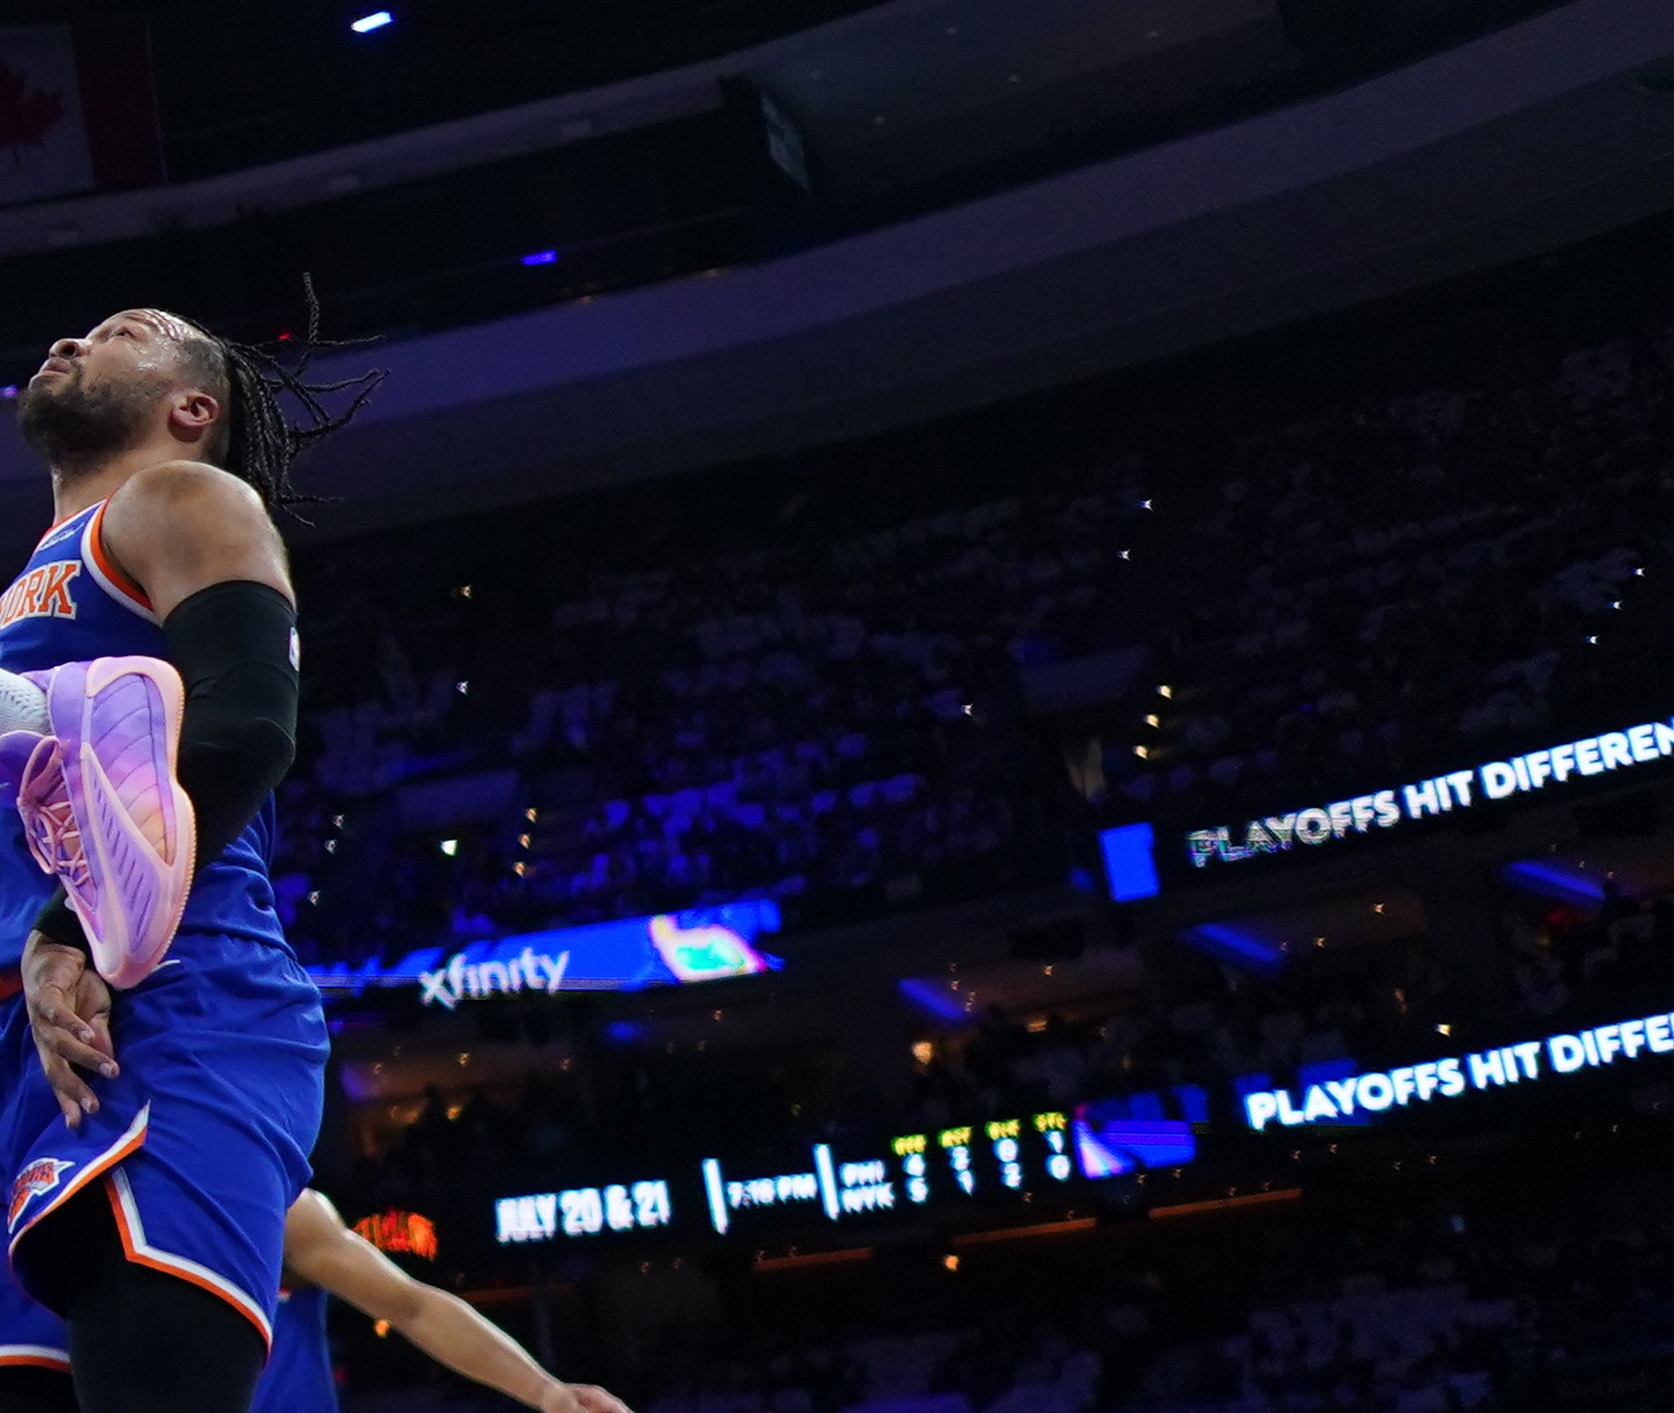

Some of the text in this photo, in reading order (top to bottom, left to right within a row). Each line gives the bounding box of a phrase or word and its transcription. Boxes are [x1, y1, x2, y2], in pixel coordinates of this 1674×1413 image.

[1188, 789, 1402, 868] PLAYOFFS
[1403, 770, 1474, 819] HIT
[417, 946, 570, 1010] xfinity
[1244, 1041, 1541, 1132] PLAYOFFS HIT
[495, 1193, 557, 1245] JULY
[560, 1188, 603, 1236] 20
[605, 1185, 634, 1231] &
[633, 1180, 672, 1227] 21
[777, 1173, 817, 1201] PM
[840, 1182, 895, 1214] NYK
